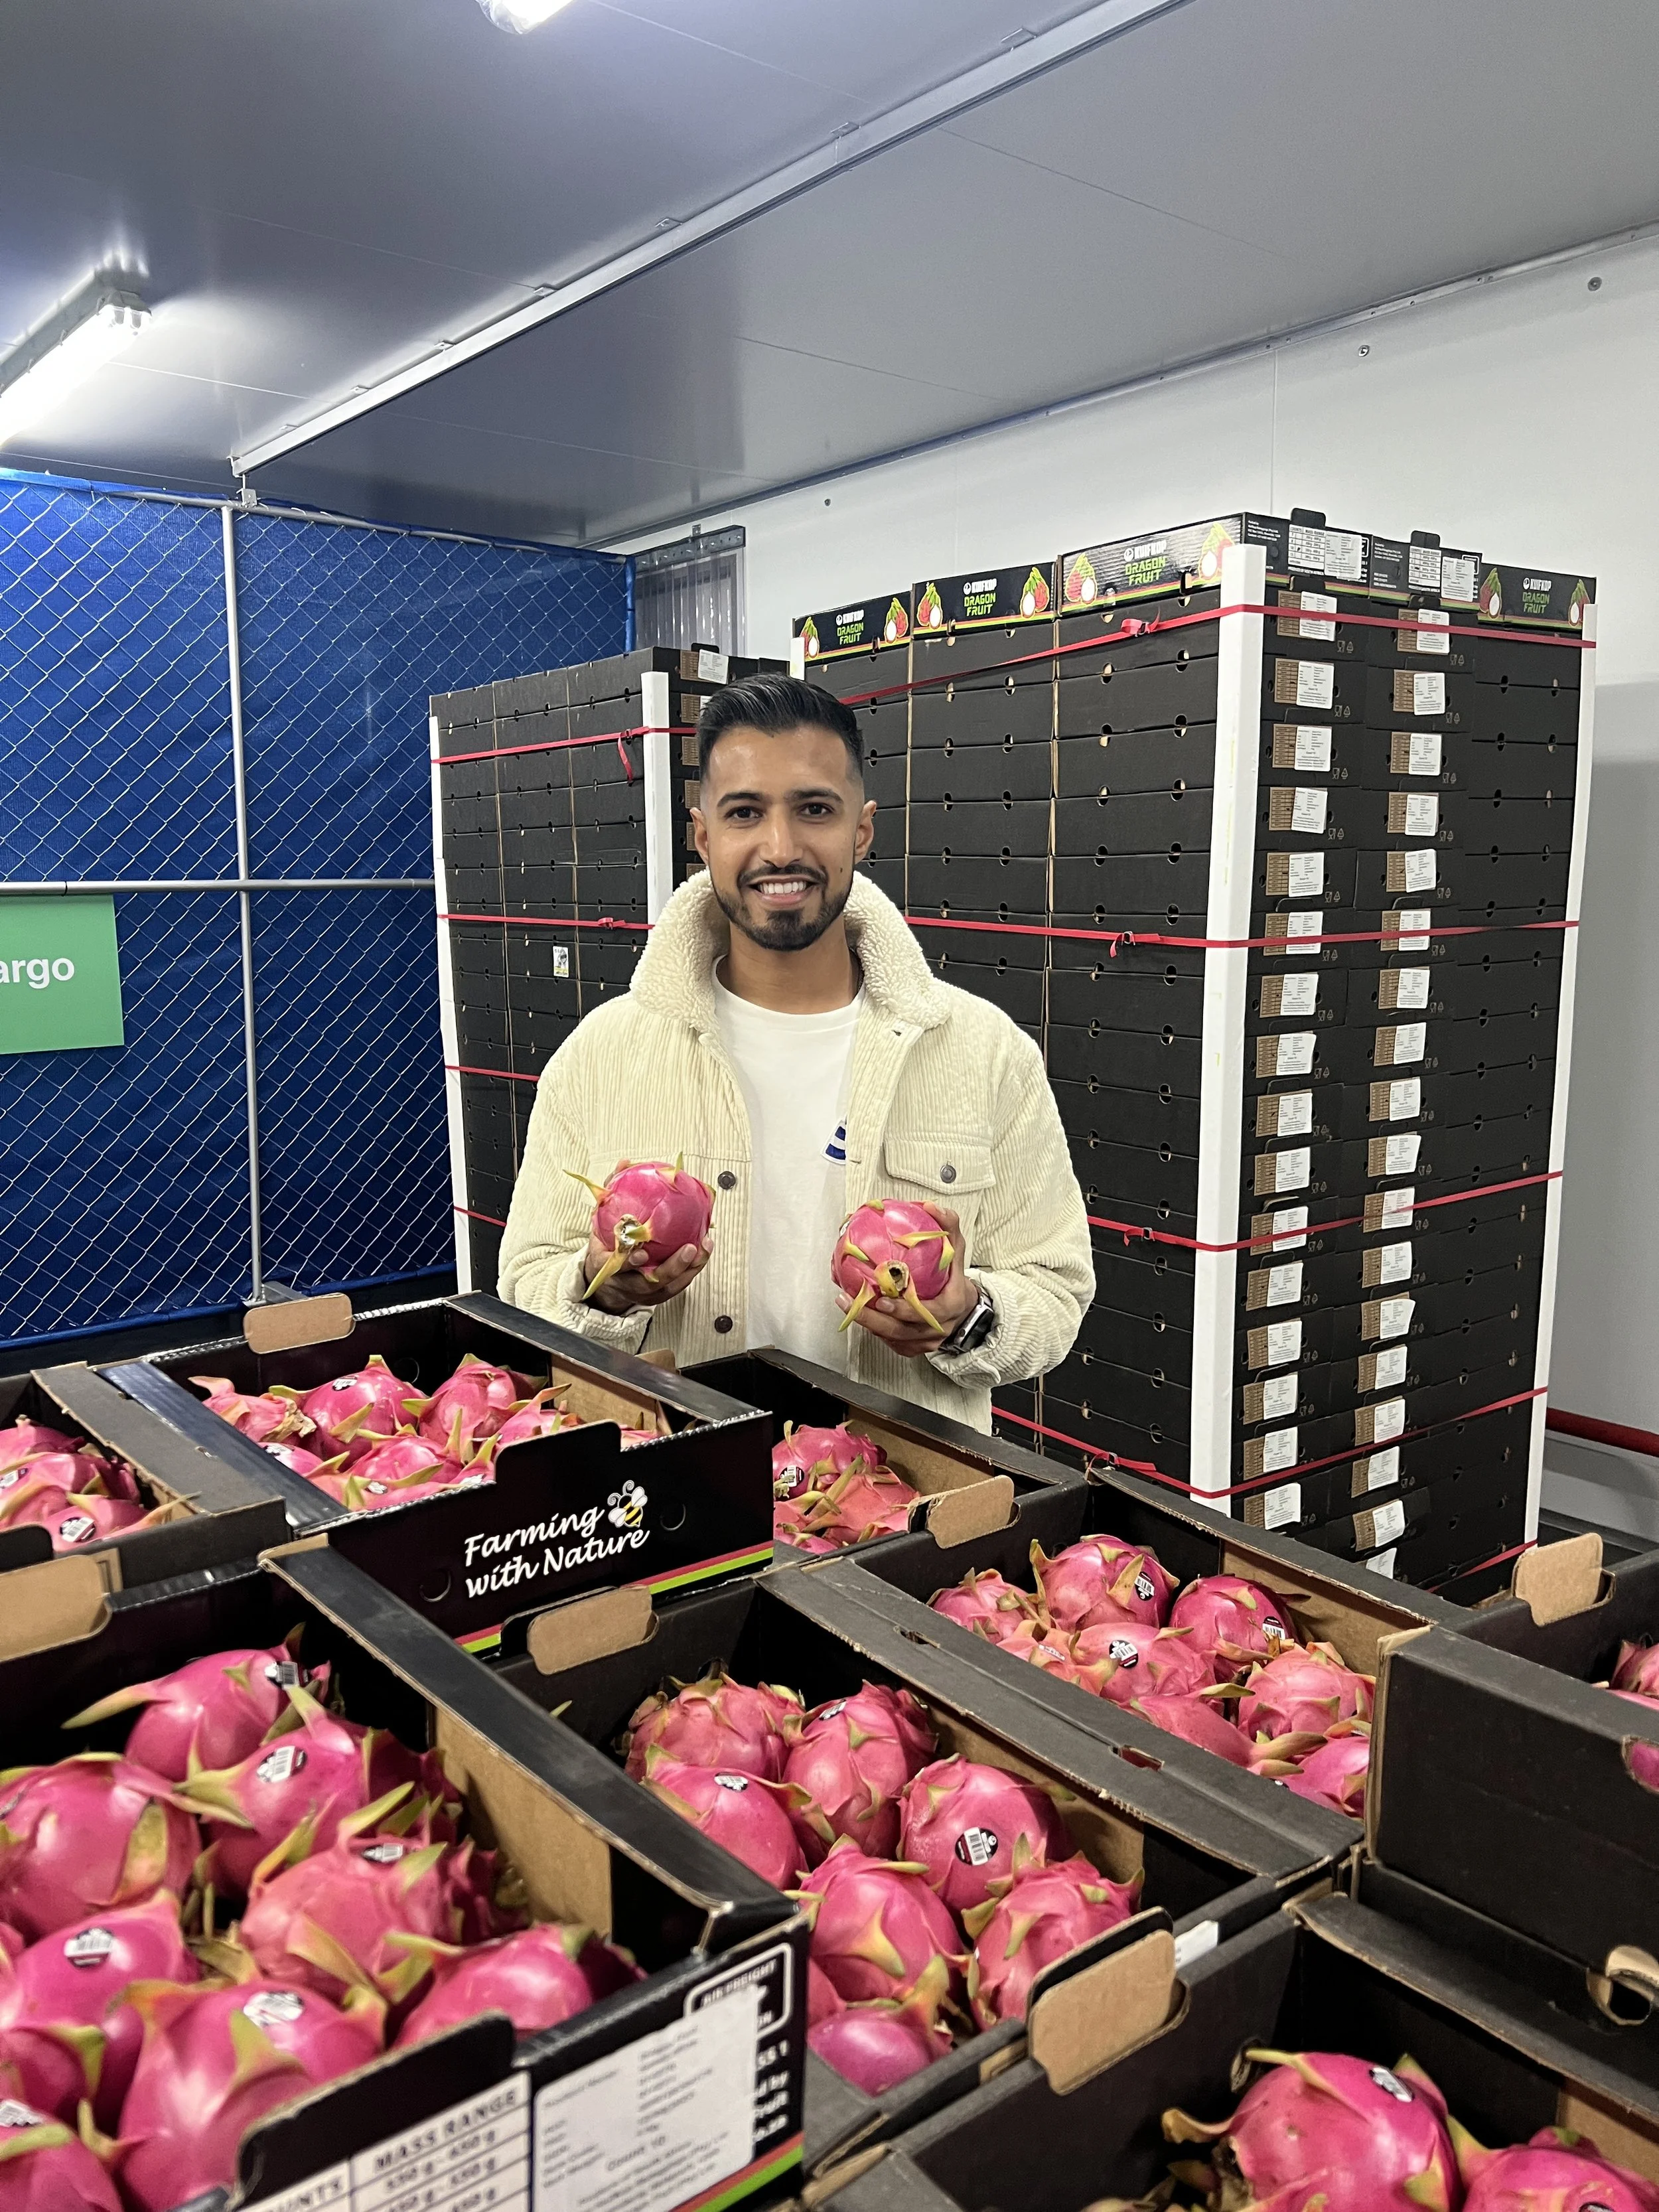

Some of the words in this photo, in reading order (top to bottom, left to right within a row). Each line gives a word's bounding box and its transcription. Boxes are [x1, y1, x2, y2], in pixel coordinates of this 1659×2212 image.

[1125, 556, 1167, 575] DRAGON
[1129, 569, 1162, 585] FRUIT
[964, 592, 996, 607] DRAGON
[1522, 591, 1550, 604] DRAGON
[966, 603, 993, 617] FRUIT
[1524, 603, 1547, 614] FRUIT
[837, 622, 863, 636] DRAGON
[839, 632, 862, 645] FRUIT
[465, 1506, 605, 1567] Farming
[465, 1554, 540, 1598] with
[543, 1528, 650, 1576] Nature
[376, 2130, 437, 2170] MASS
[446, 2089, 516, 2134] RANGE
[607, 2145, 646, 2172] Count
